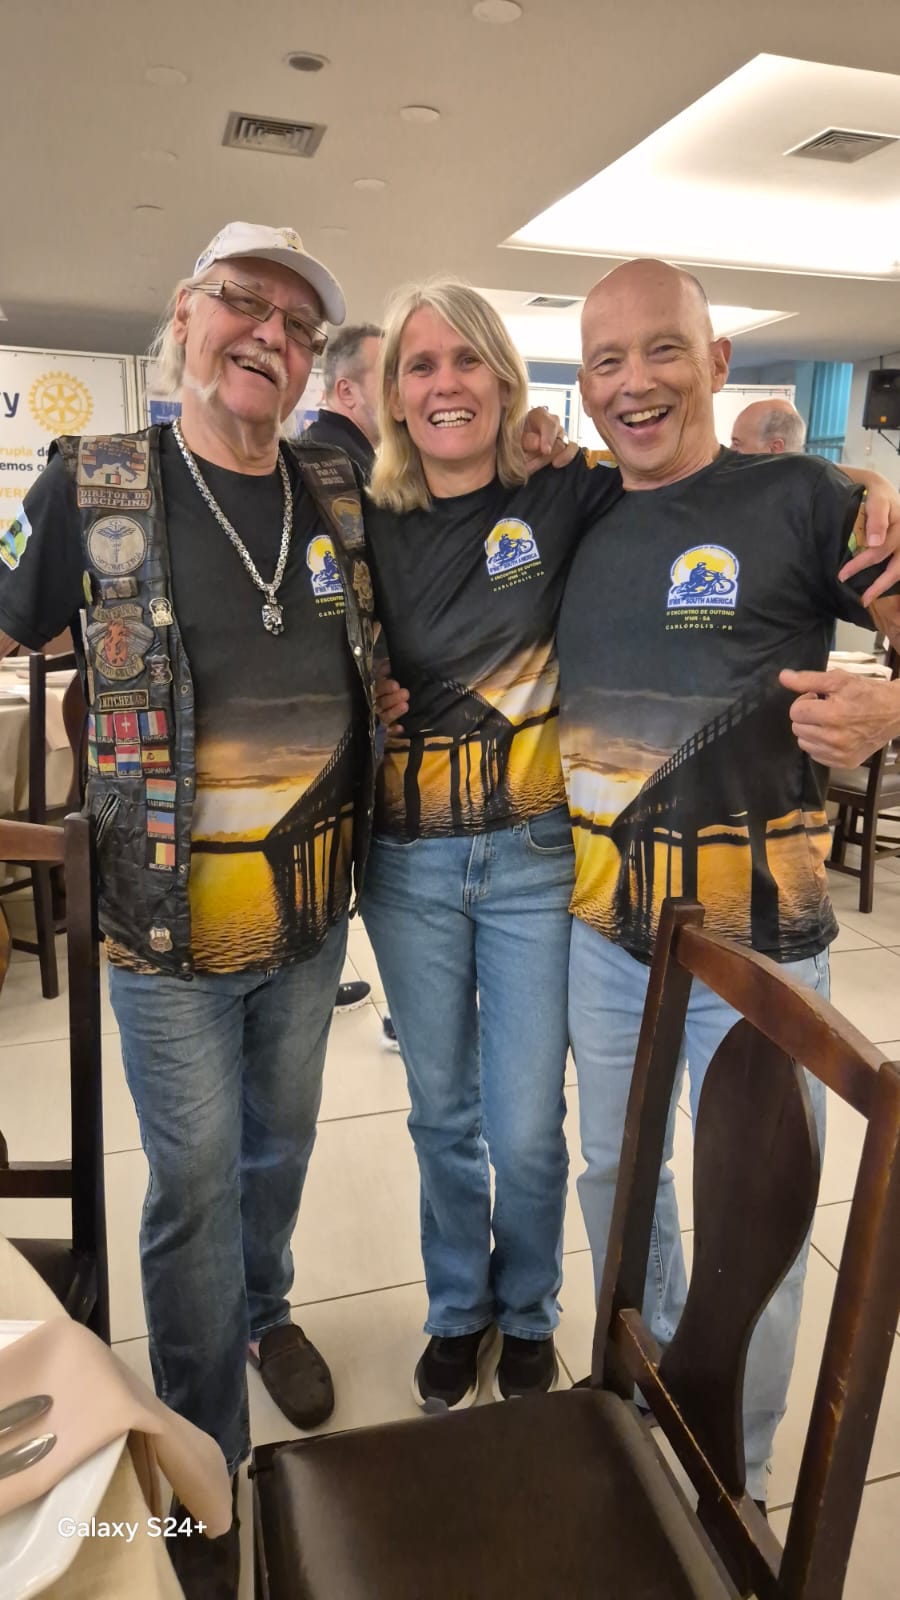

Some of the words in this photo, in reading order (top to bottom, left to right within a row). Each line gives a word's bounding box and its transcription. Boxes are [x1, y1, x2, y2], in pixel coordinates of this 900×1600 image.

[0, 391, 20, 418] y
[80, 489, 129, 500] DIRETOR
[135, 491, 148, 500] DE
[80, 497, 148, 507] DISCIPLINA
[686, 597, 705, 605] SOUTH
[705, 597, 733, 605] AMERICA
[709, 609, 735, 617] OUTONO
